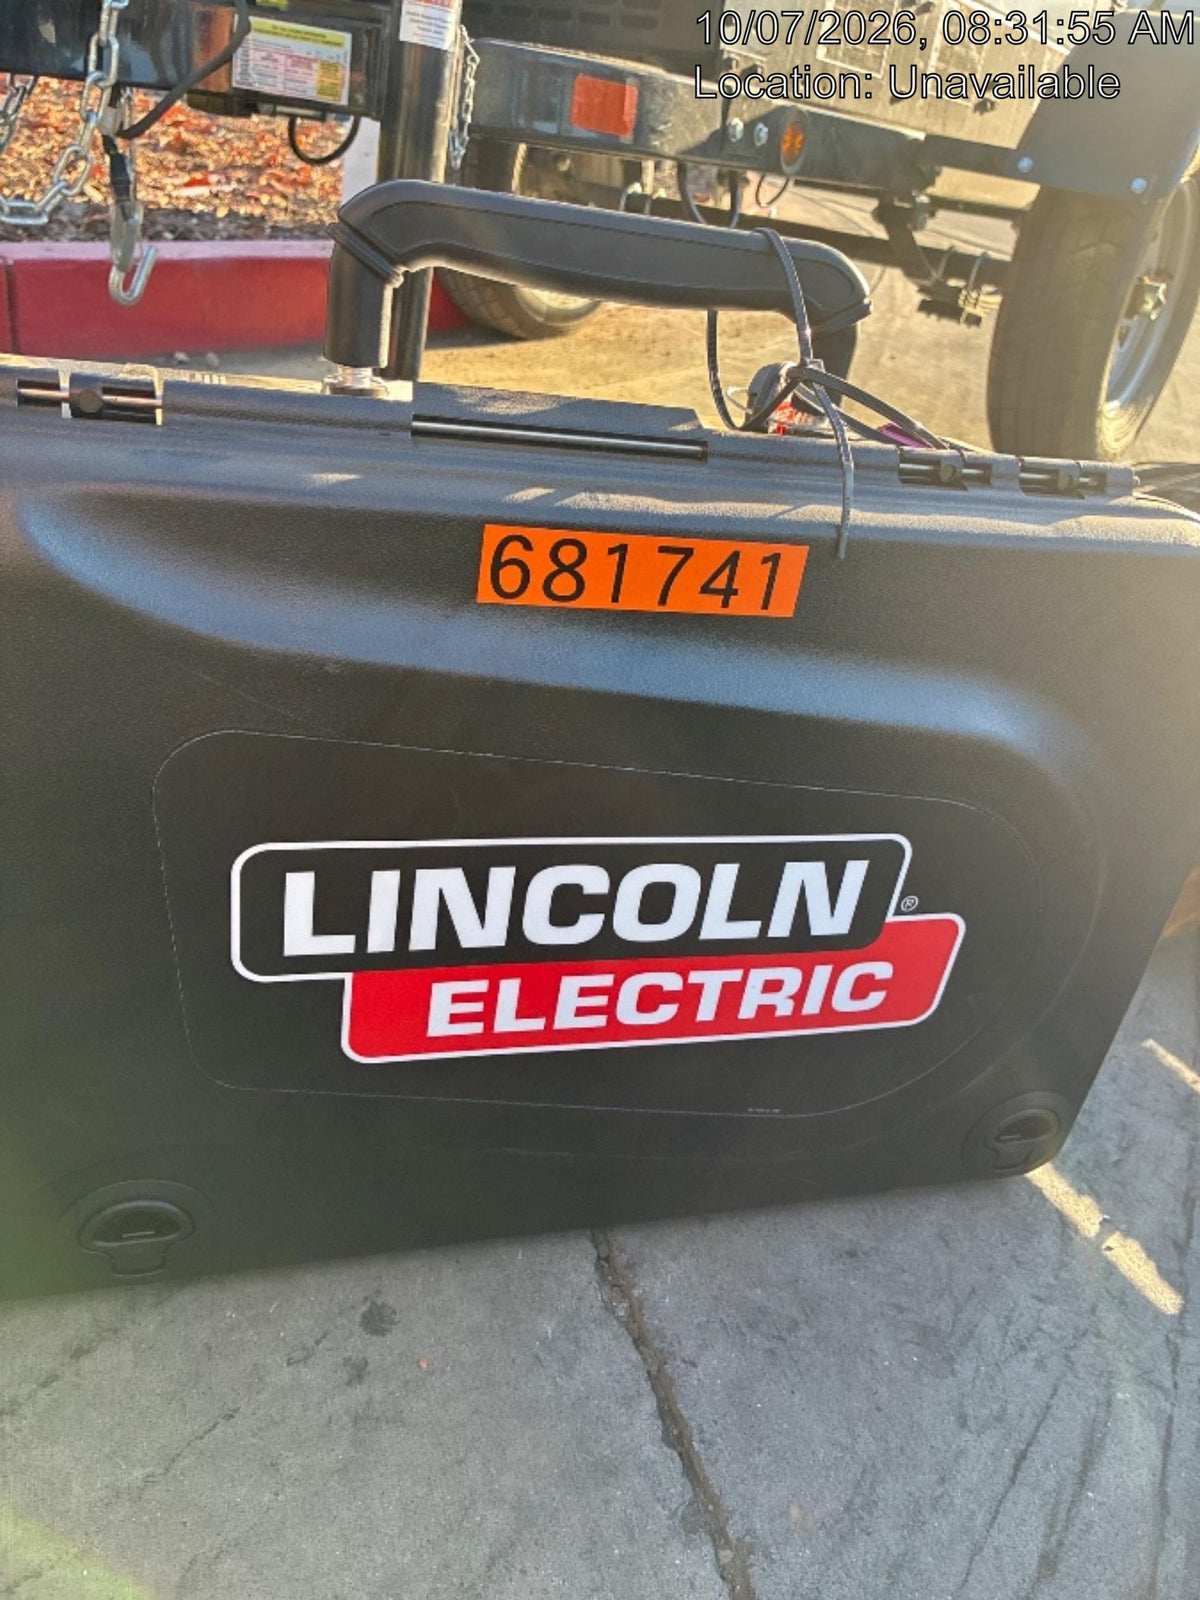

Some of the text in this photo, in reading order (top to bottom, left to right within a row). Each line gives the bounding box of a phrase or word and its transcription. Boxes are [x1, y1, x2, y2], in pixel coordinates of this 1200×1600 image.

[490, 534, 781, 611] 681741
[283, 859, 869, 957] LINCOLN
[426, 961, 894, 1038] ELECTRIC
